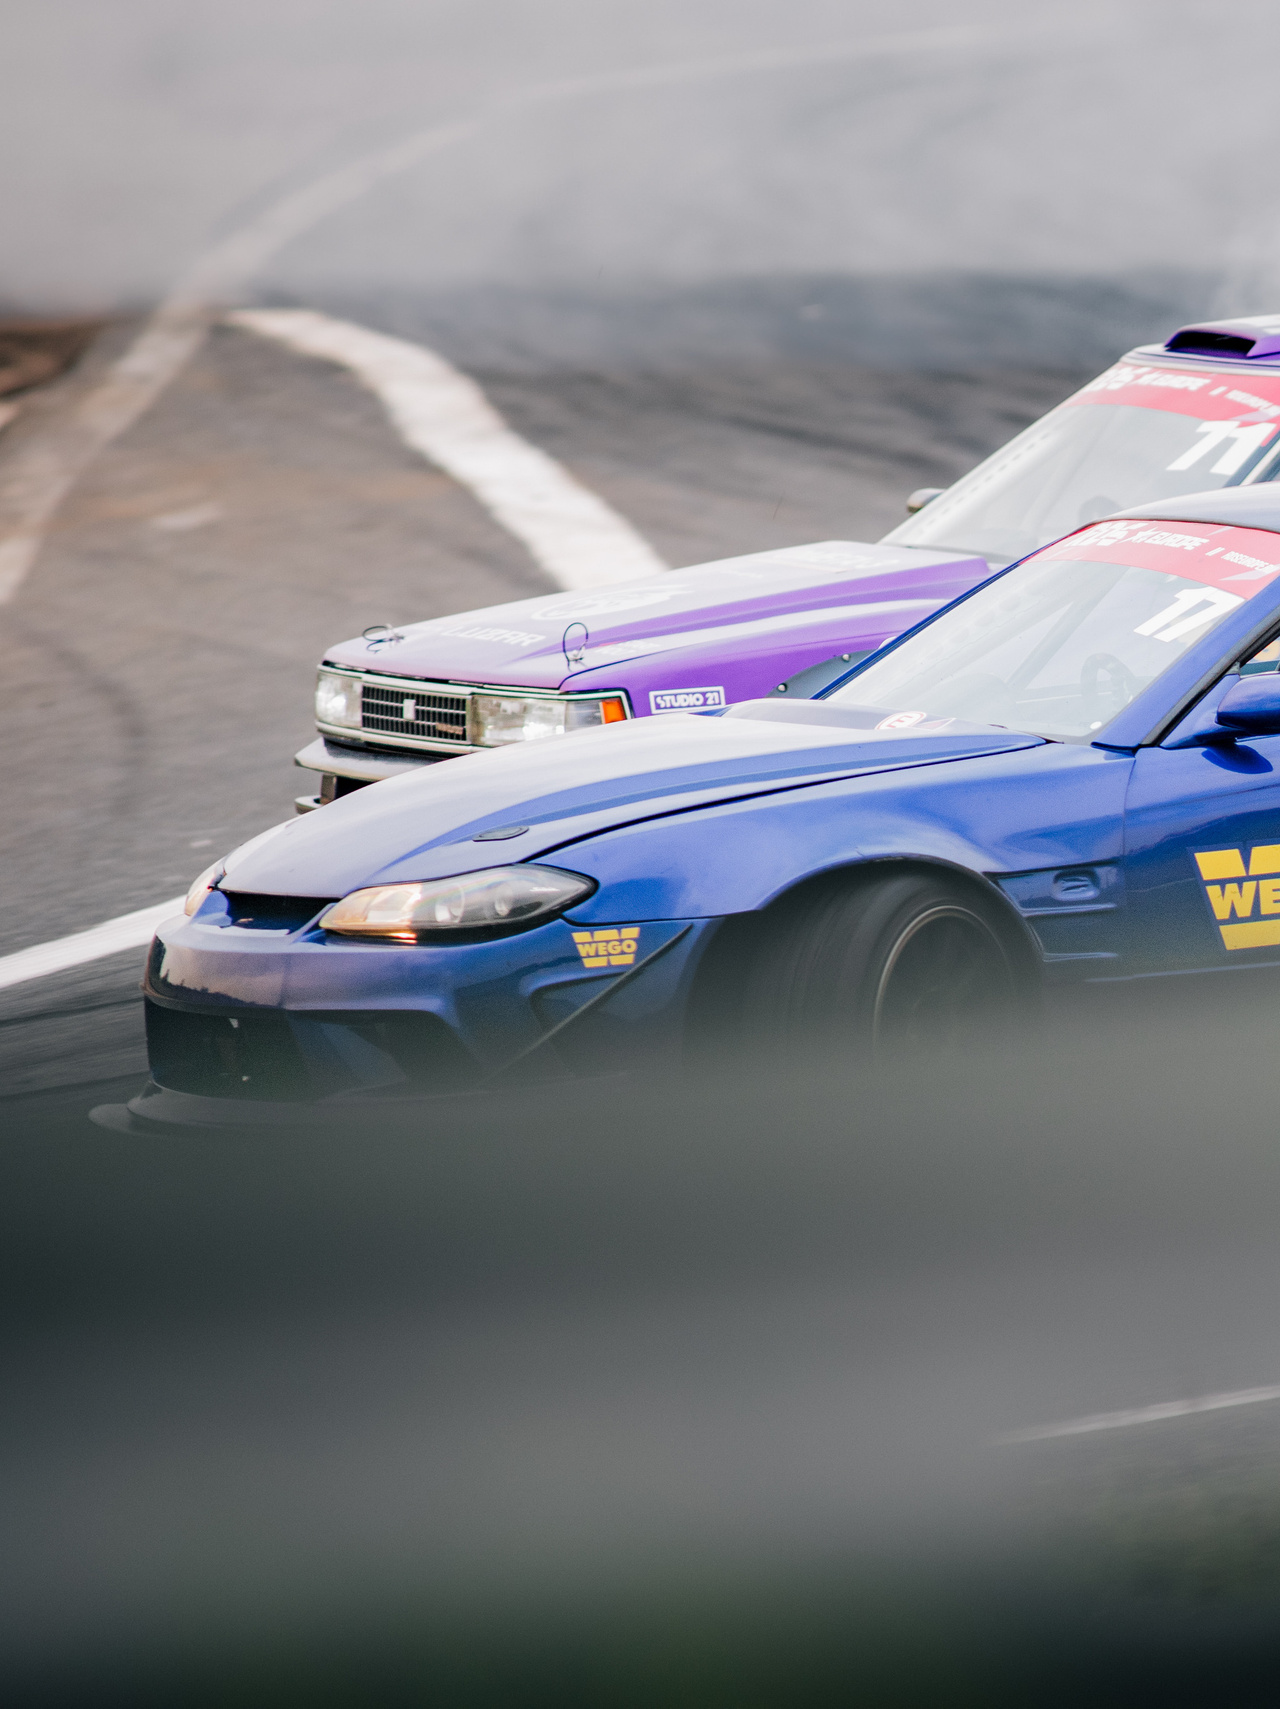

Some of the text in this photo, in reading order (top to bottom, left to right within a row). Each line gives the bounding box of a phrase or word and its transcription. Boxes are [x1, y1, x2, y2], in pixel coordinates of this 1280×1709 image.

[1133, 586, 1245, 643] 17
[441, 626, 547, 647] LUZAR
[655, 692, 720, 708] STUDIO 21
[577, 939, 638, 957] WEGO
